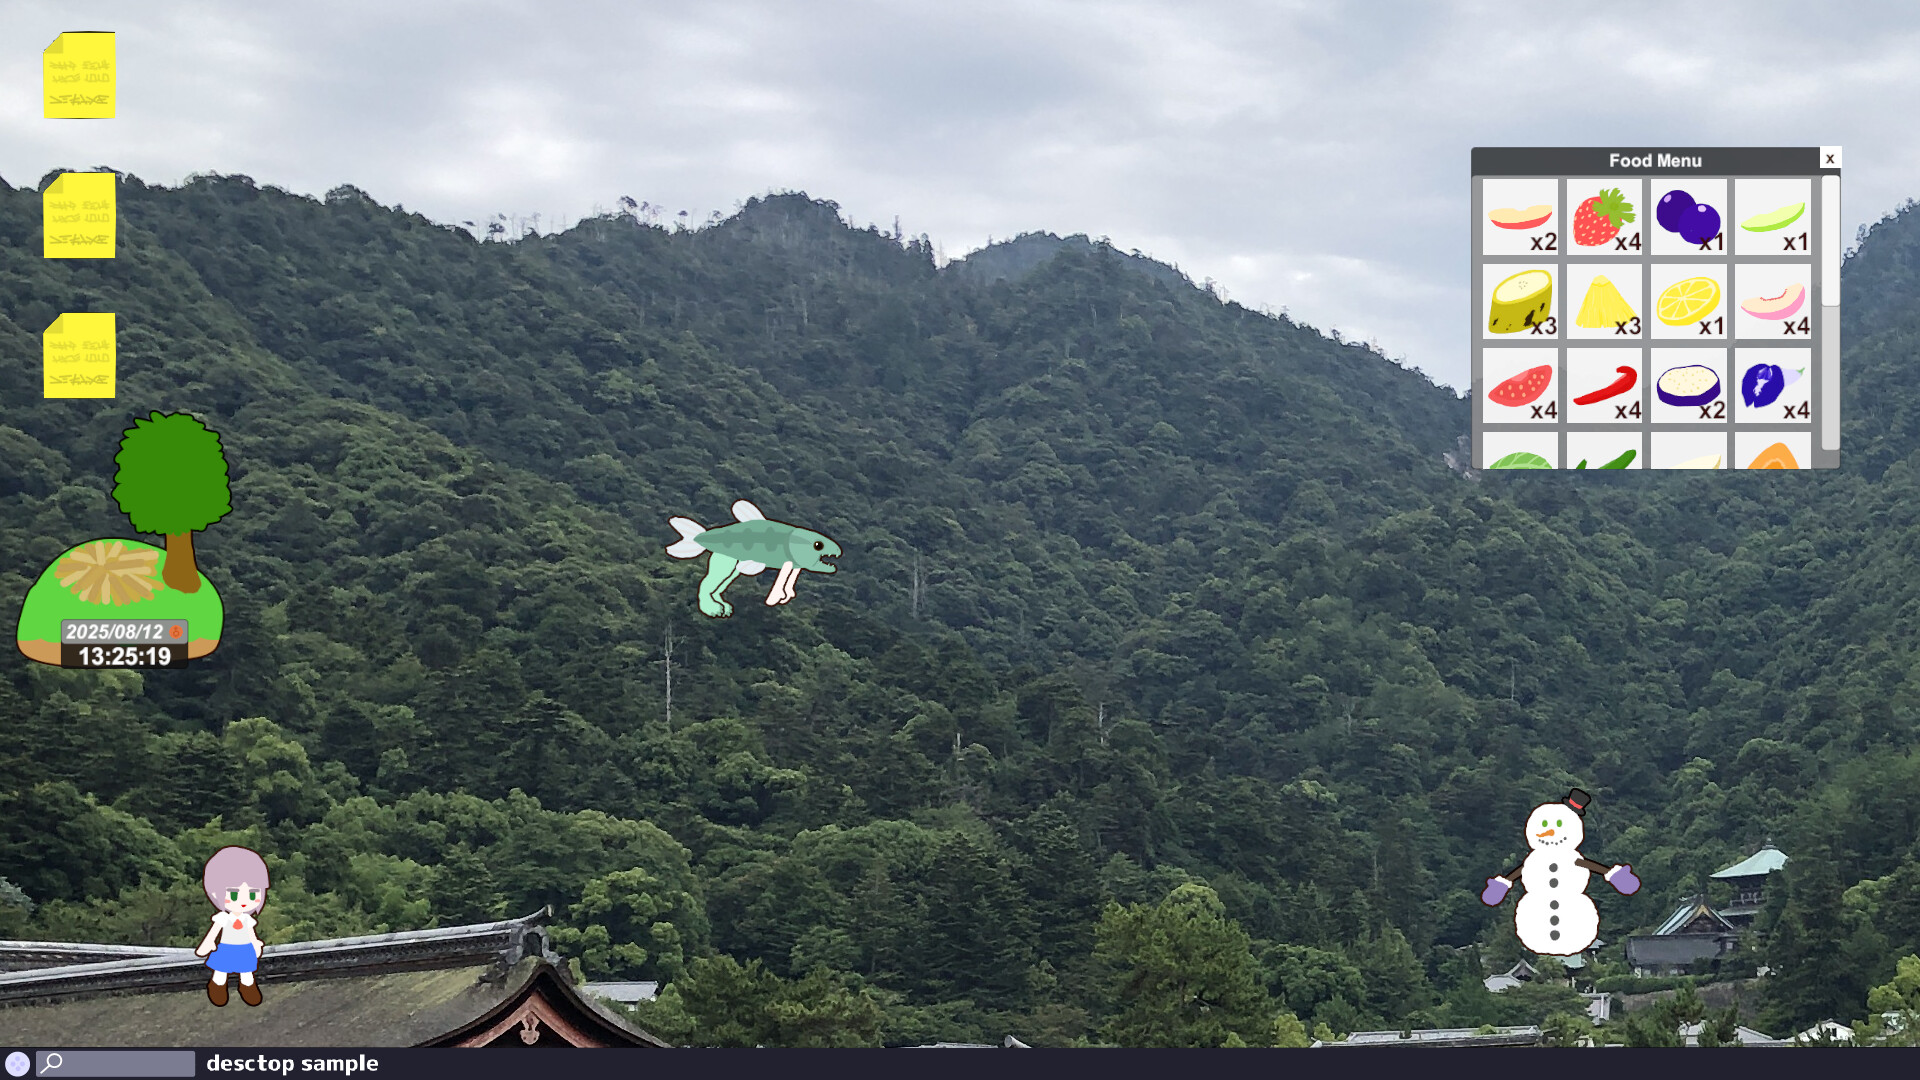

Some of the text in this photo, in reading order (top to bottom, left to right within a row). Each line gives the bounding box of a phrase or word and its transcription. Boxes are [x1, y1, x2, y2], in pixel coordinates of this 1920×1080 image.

[1609, 153, 1702, 168] Food Menu
[1531, 233, 1557, 251] x2
[1615, 233, 1642, 251] x4
[1699, 233, 1724, 251] x1
[1783, 233, 1808, 251] x1
[1531, 317, 1557, 335] x3
[1615, 317, 1642, 335] x3
[1699, 317, 1724, 335] x1
[1783, 317, 1810, 335] x4
[1531, 401, 1557, 419] x4
[1615, 401, 1642, 419] x4
[1699, 401, 1726, 419] x2
[1783, 401, 1810, 419] x4
[66, 624, 163, 640] 2025/08/12
[79, 647, 171, 666] 13:25:19
[206, 1054, 379, 1075] desctop sample
